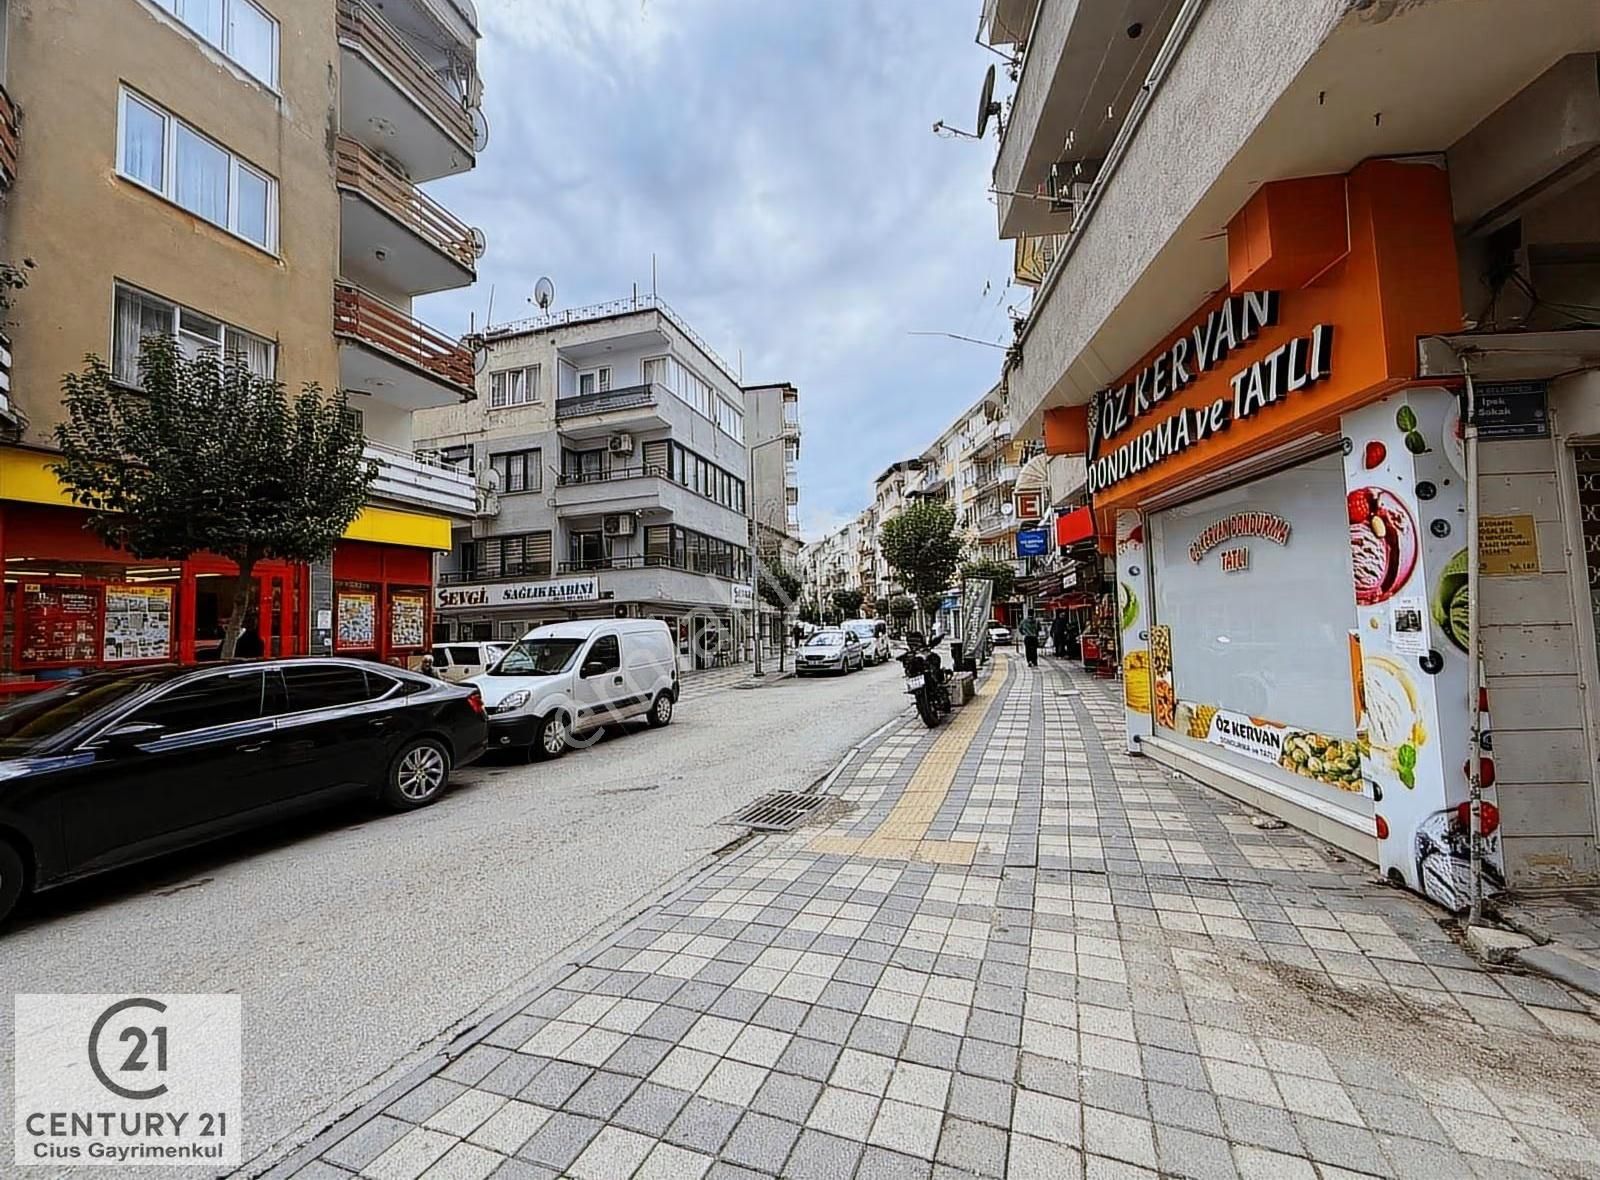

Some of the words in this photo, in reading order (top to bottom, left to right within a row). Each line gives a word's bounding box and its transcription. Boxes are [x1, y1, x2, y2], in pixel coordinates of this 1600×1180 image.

[1102, 384, 1130, 440] ÖZ
[1134, 290, 1276, 417] KERVAN
[1088, 407, 1192, 494] DONDURMA
[1196, 398, 1228, 440] ve
[1230, 324, 1330, 421] TATLI
[1230, 512, 1291, 546] DONDURMA
[1220, 546, 1248, 571] TATLI
[502, 586, 547, 600] SAĞLIK
[548, 580, 594, 598] KABİNİ
[1216, 715, 1230, 734] ÖZ
[1232, 721, 1280, 748] KERVAN
